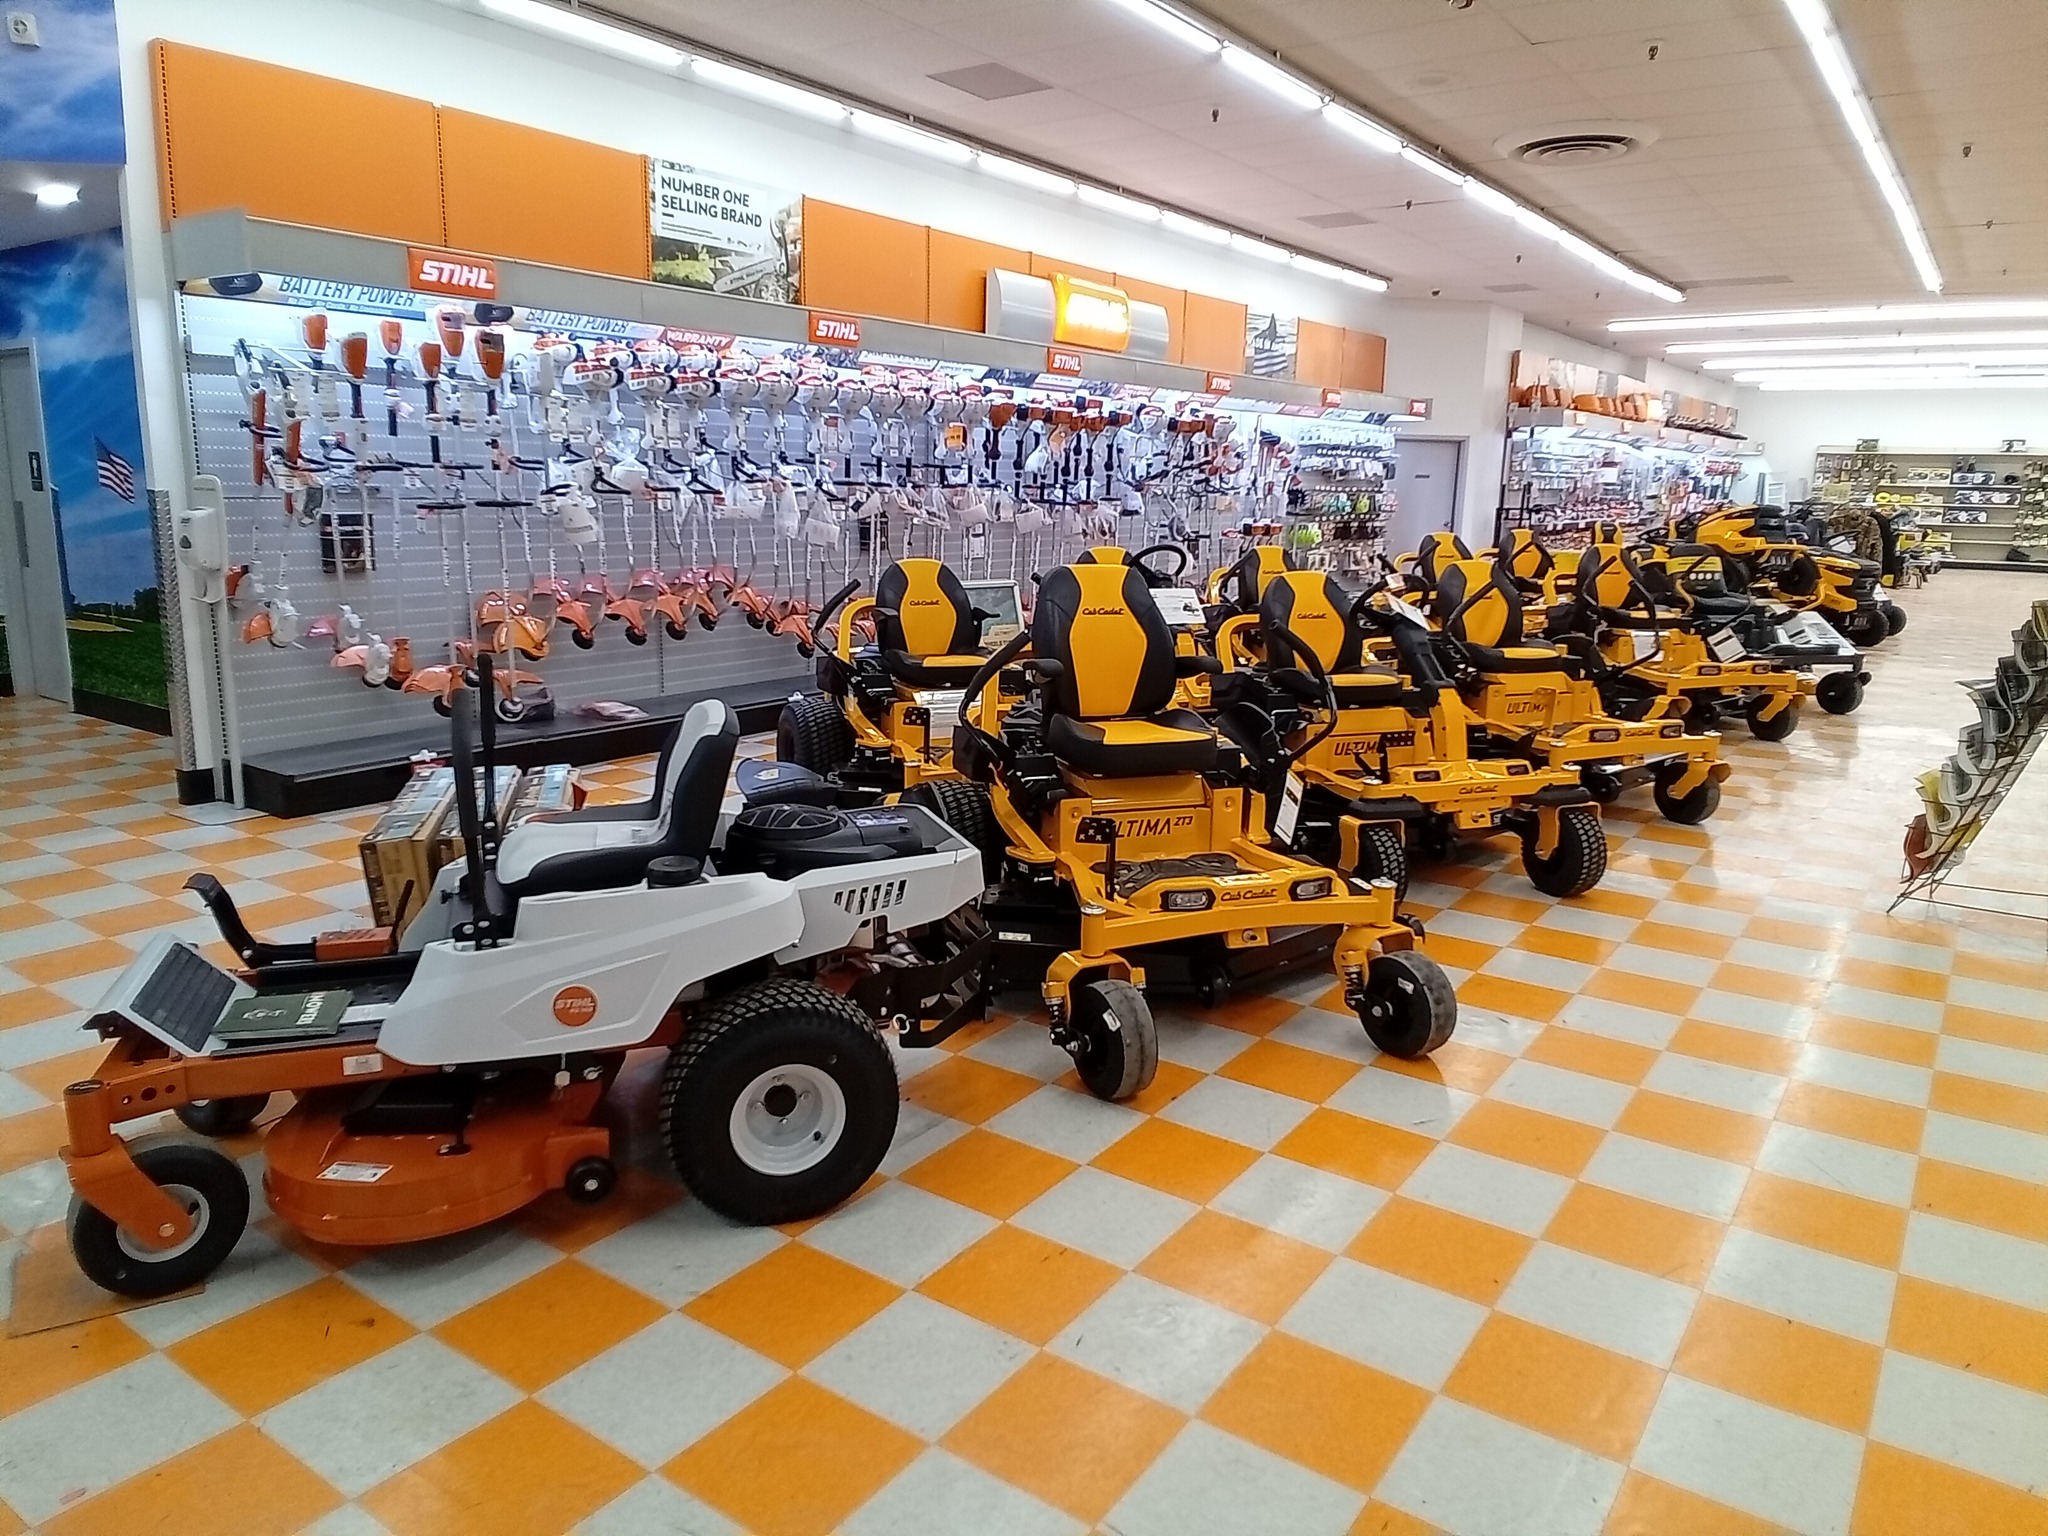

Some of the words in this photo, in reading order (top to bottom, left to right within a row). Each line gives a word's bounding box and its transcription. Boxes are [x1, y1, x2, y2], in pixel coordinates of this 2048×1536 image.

[661, 175, 720, 201] NUMBER
[723, 190, 750, 207] ONE
[661, 195, 718, 218] SELLING
[721, 207, 762, 227] BRAND
[419, 259, 495, 290] STIHL
[278, 275, 354, 301] BATTERY
[356, 286, 416, 307] POWER
[525, 308, 583, 328] BATTERY
[583, 315, 630, 333] POWER
[815, 319, 860, 341] STIHL
[666, 330, 732, 348] WARRANTY
[1052, 354, 1082, 371] STIHL
[1082, 607, 1097, 616] Cub
[1097, 607, 1125, 616] Cadet
[1506, 701, 1547, 714] ULTIM
[1334, 740, 1381, 756] ULTIM
[1111, 817, 1172, 838] LTIMA
[1220, 890, 1242, 901] Cub
[1242, 888, 1278, 900] Cadet
